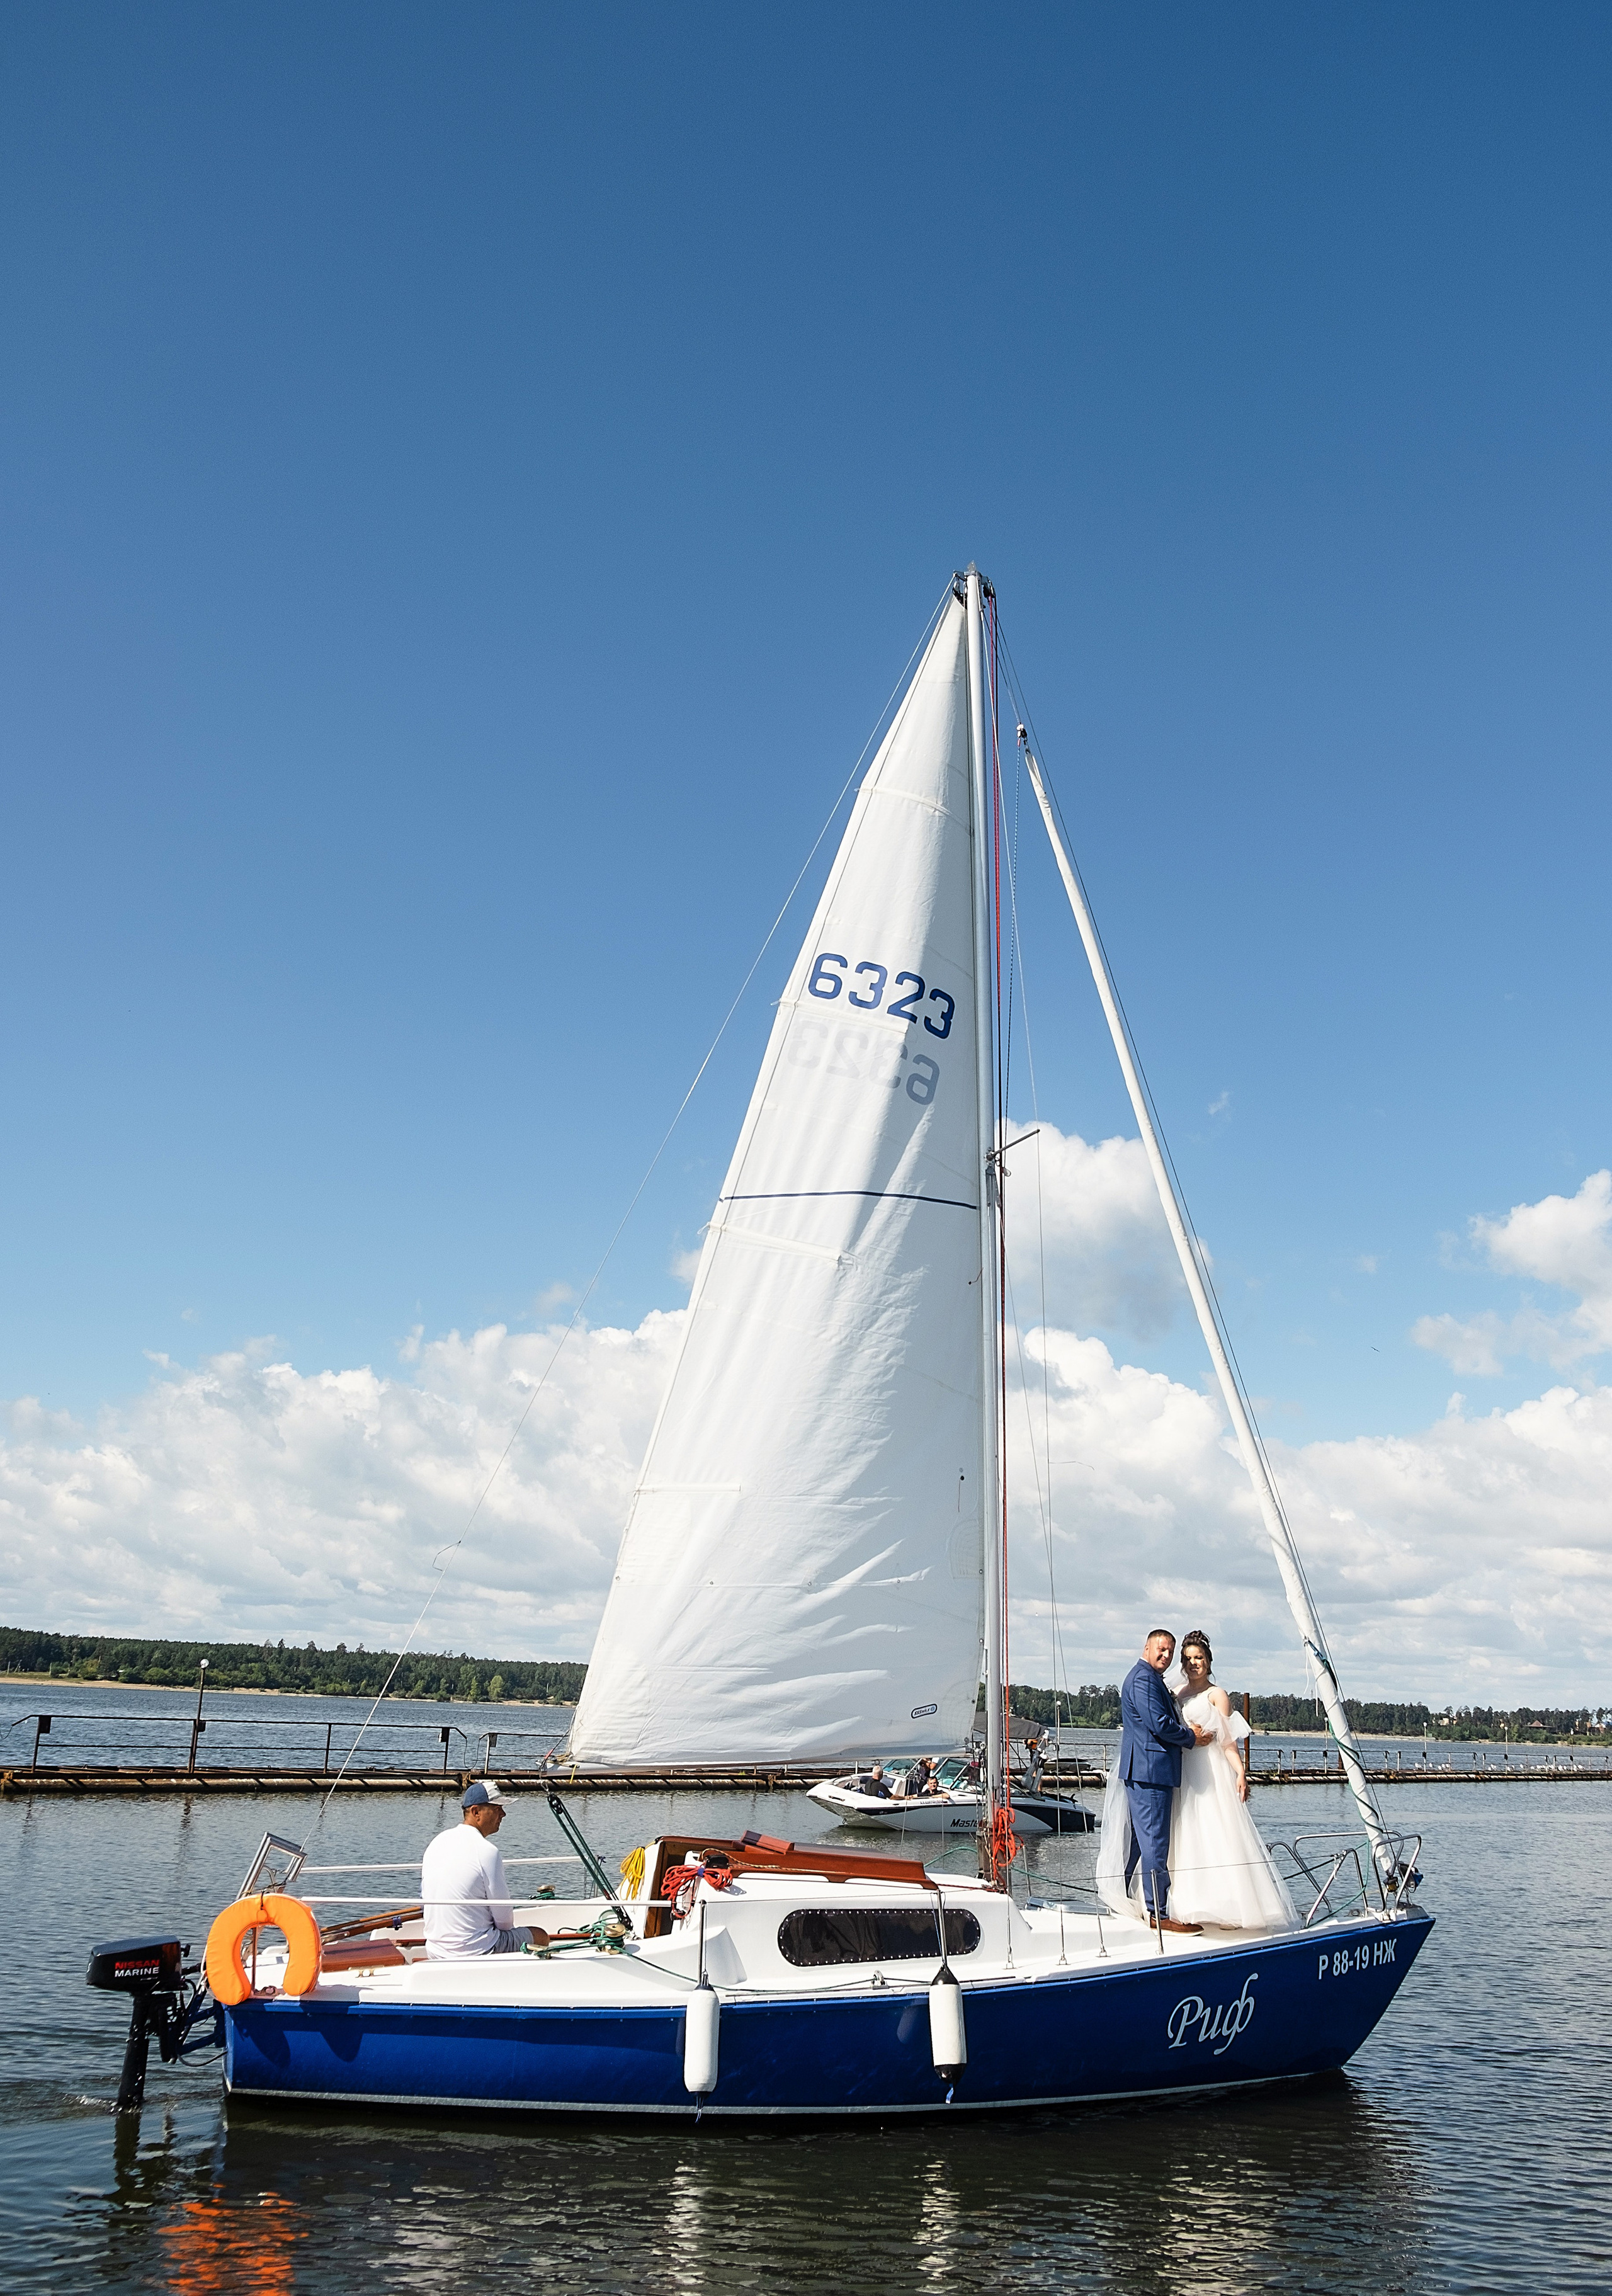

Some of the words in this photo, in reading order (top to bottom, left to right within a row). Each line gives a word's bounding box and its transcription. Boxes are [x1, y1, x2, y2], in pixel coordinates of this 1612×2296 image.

[808, 952, 955, 1040] 6323
[115, 1959, 160, 1969] NISSAN
[115, 1967, 160, 1977] MARINE
[1319, 1955, 1329, 1980] Р
[1332, 1945, 1370, 1976] 88-19
[1373, 1938, 1397, 1966] НЖ
[1167, 1972, 1259, 2055] Риф
